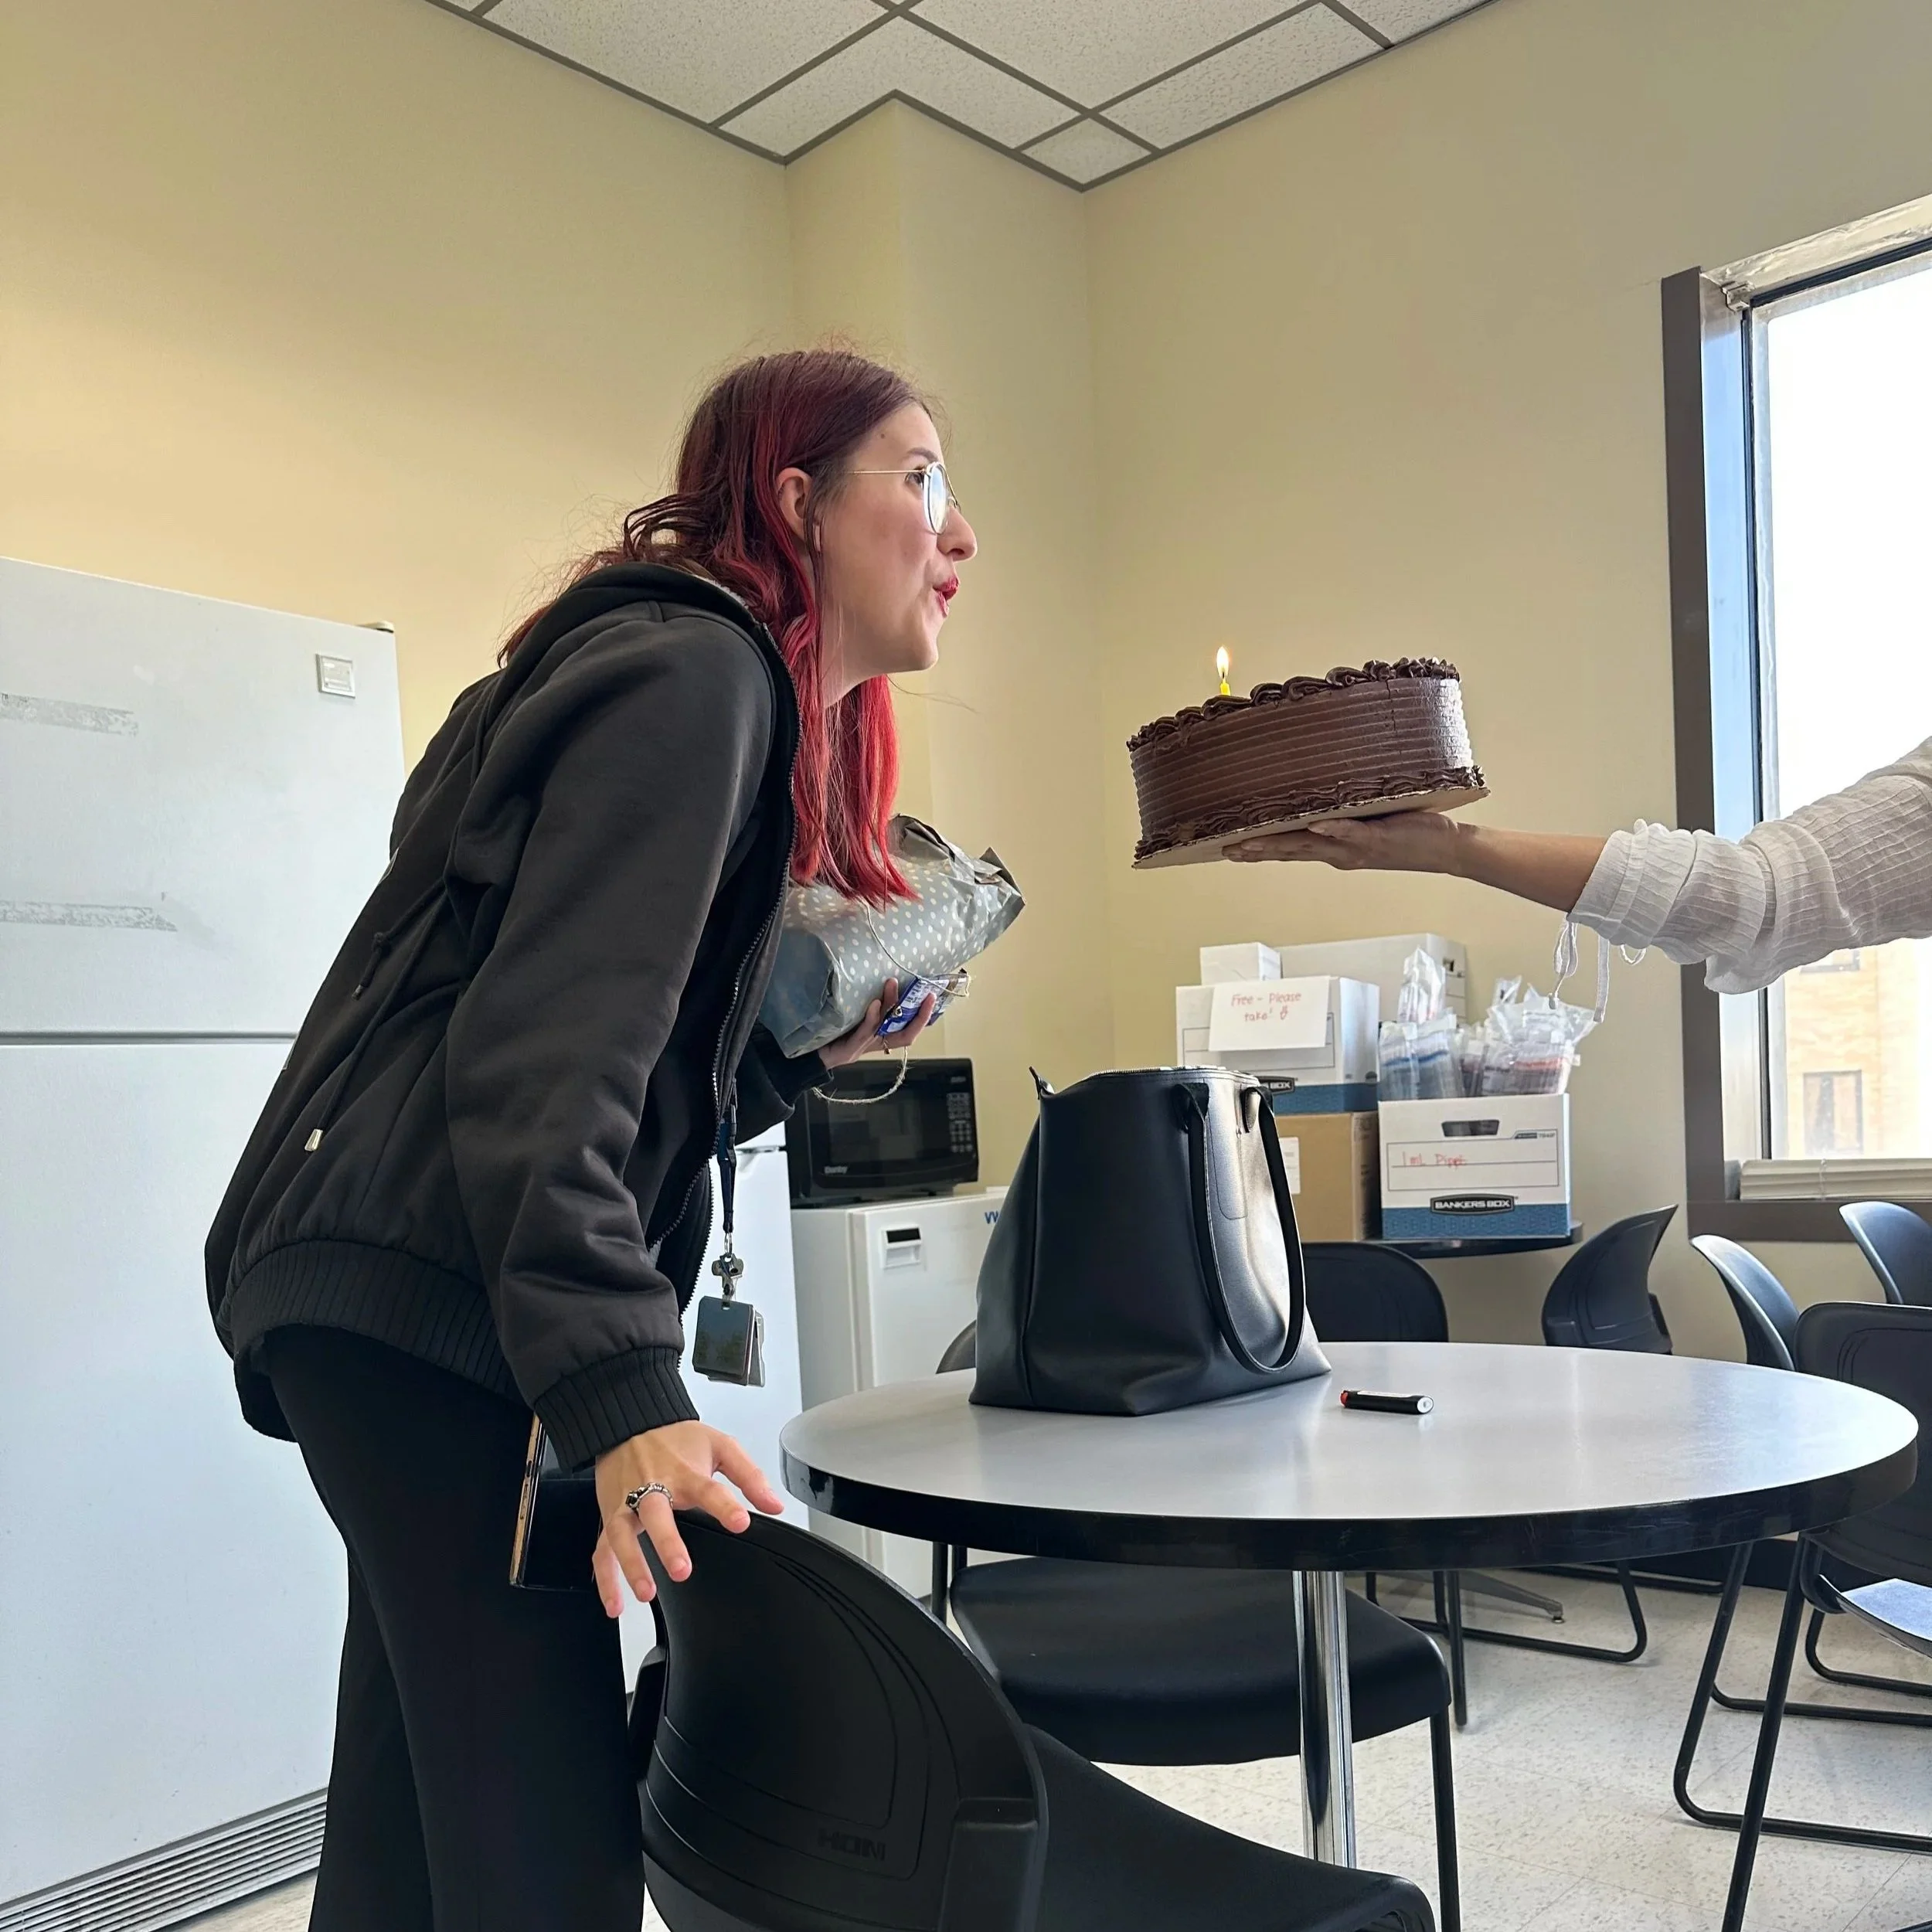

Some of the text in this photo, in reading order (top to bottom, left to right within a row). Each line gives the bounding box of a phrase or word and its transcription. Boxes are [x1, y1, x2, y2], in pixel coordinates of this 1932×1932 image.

[1230, 994, 1253, 1006] Free
[1270, 1081, 1291, 1090] BOX
[1434, 1199, 1511, 1209] BANKERS BOX
[818, 1828, 886, 1861] HON
